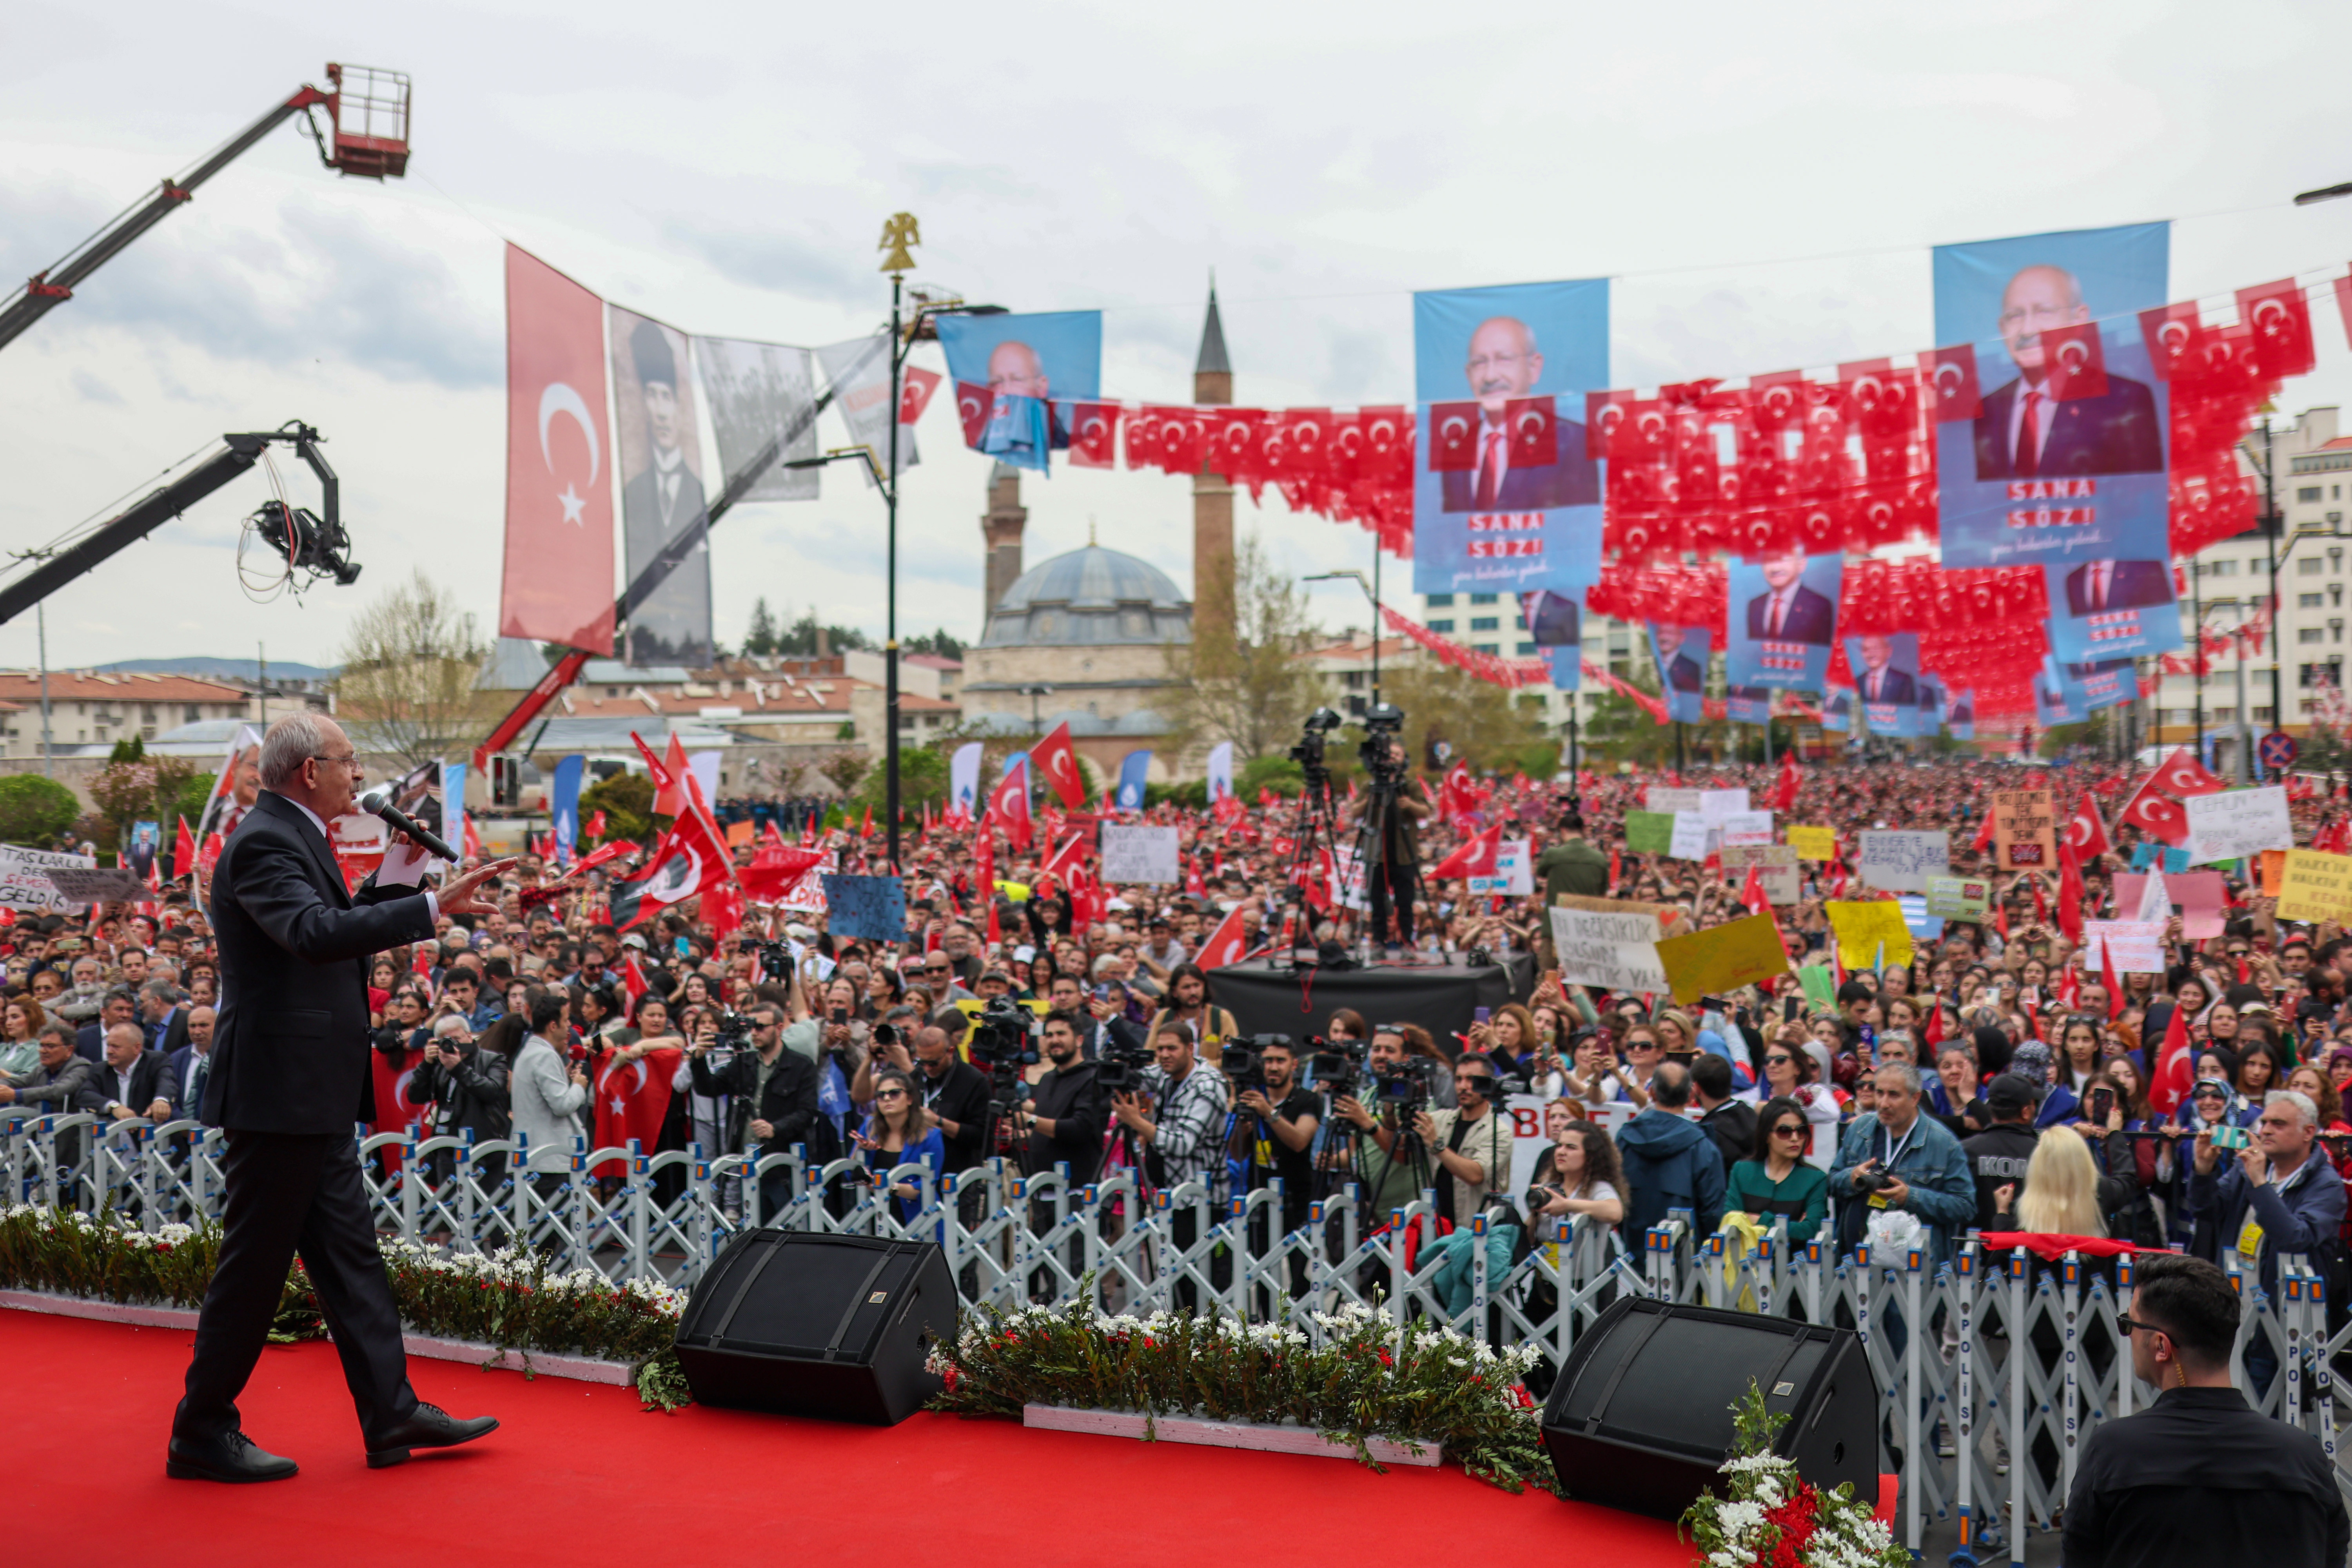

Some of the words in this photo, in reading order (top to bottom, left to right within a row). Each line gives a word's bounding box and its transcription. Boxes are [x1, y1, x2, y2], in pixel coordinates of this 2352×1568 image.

[2012, 479, 2090, 502] SANA
[1472, 512, 1541, 532] SANA
[2012, 504, 2090, 529] SÖZ!
[1472, 535, 1540, 558] SÖZ!
[3, 848, 84, 870] TAŞLARLA
[0, 886, 71, 911] GELDİK!
[1563, 941, 1618, 965] OLSUN
[1960, 1319, 1971, 1419] POLİS
[2065, 1328, 2076, 1430] POLİS
